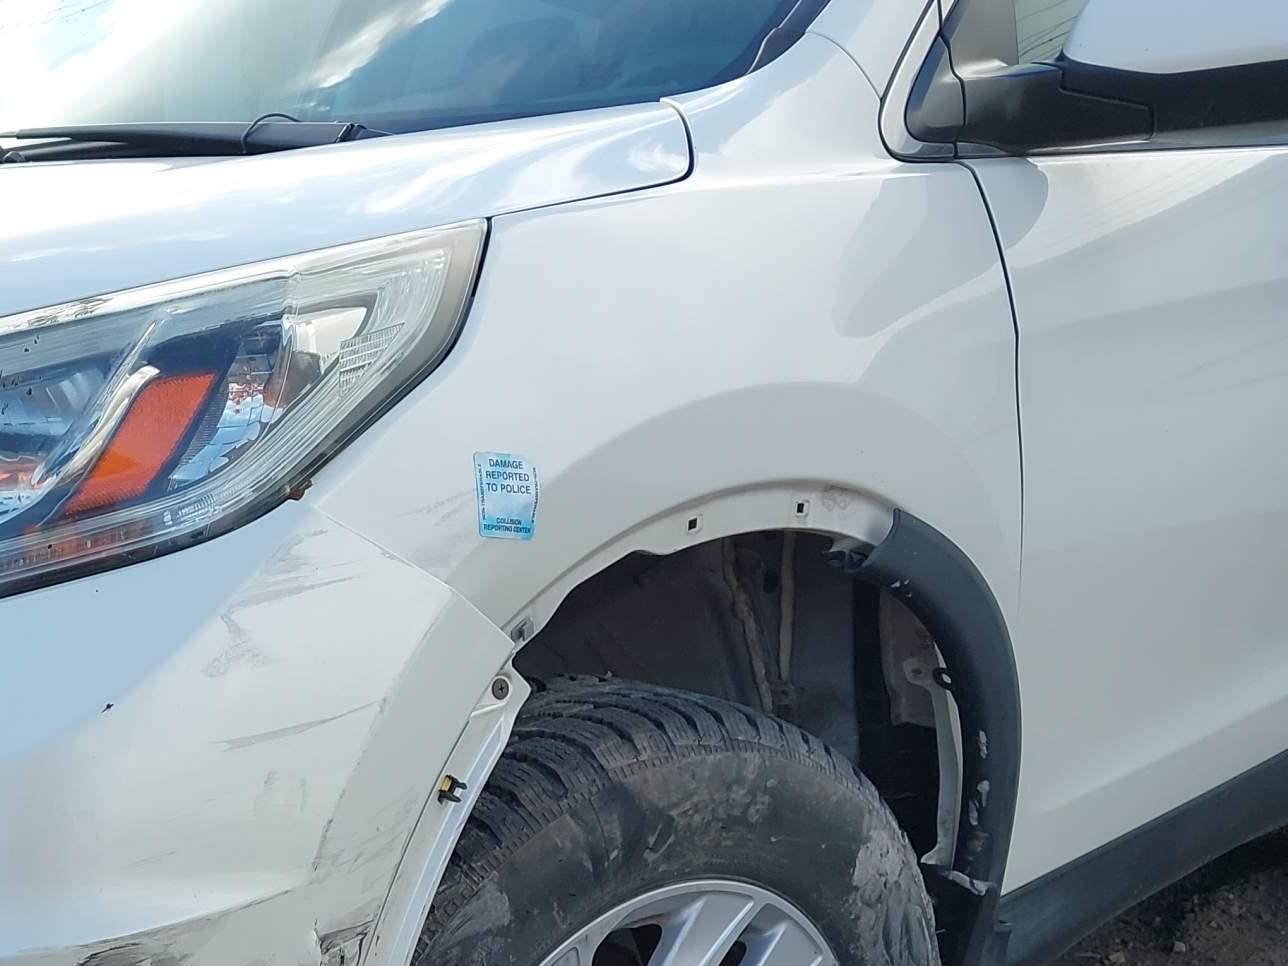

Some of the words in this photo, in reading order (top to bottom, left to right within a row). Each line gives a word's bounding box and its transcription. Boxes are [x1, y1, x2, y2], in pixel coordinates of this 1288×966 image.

[488, 459, 524, 469] DAMAGE
[485, 470, 530, 482] REPORTED
[486, 482, 498, 492] TO
[500, 483, 532, 494] POLICE
[496, 517, 522, 525] COLLISION
[484, 524, 512, 532] REPORTING
